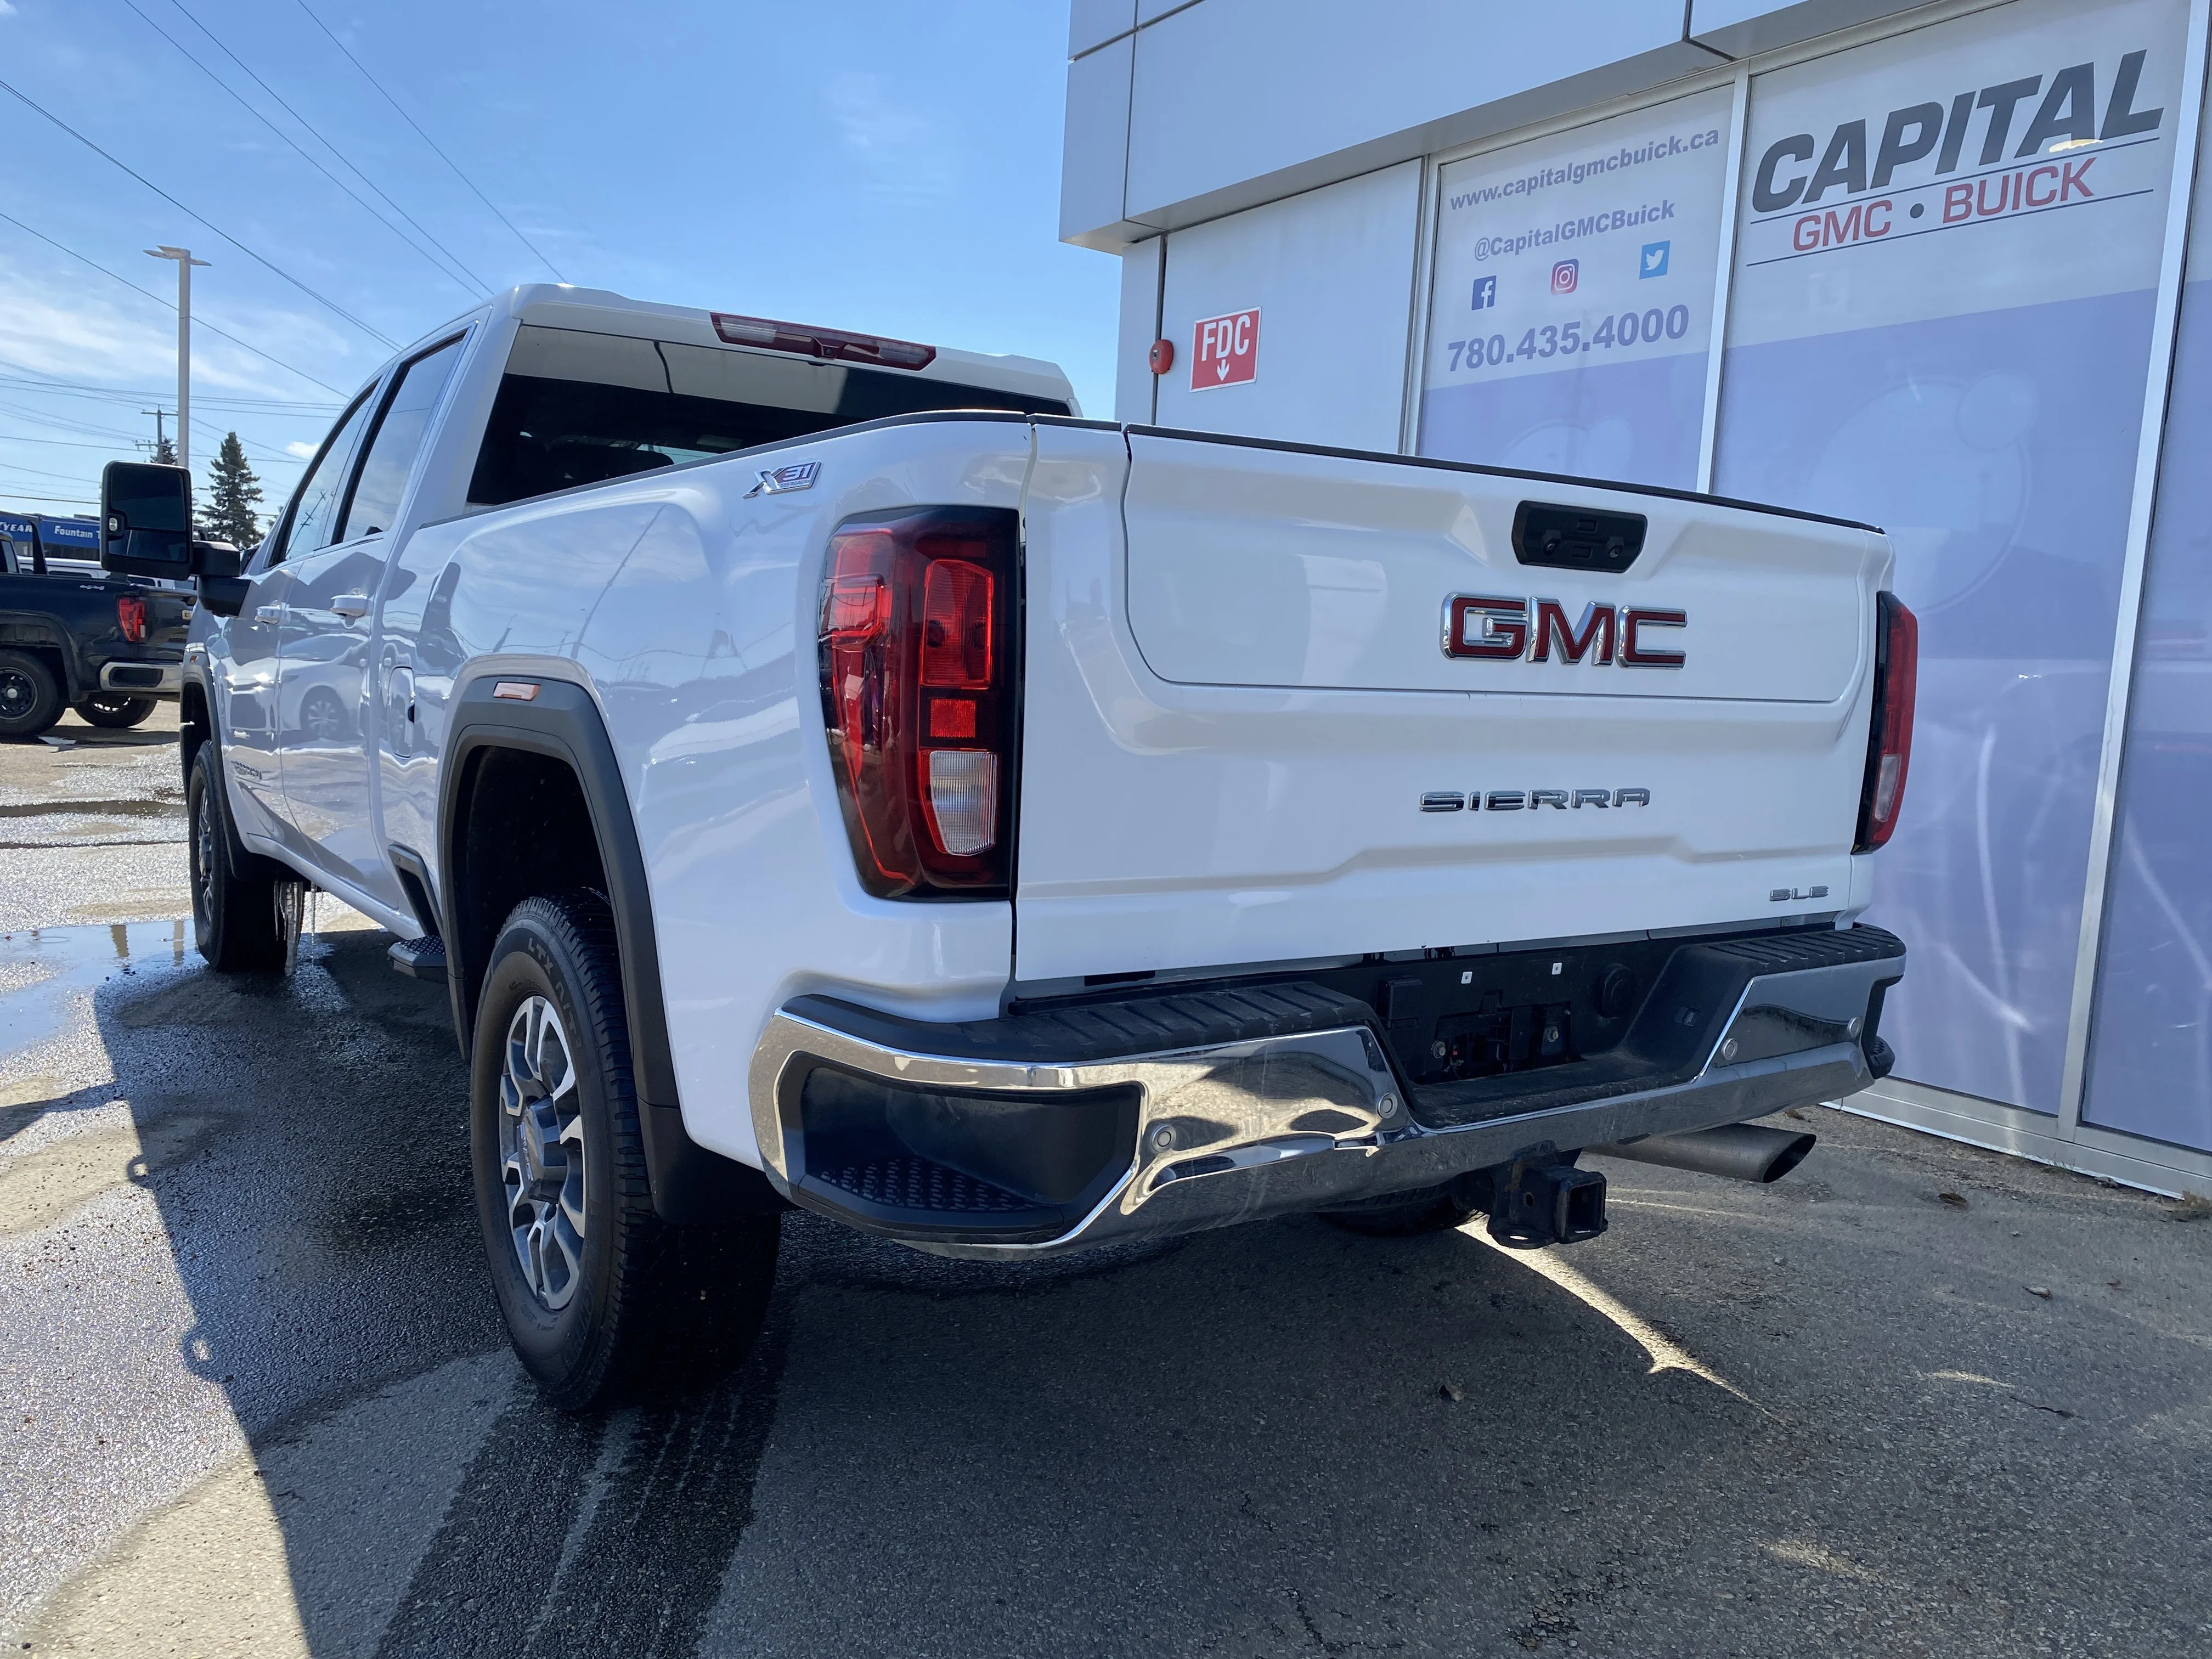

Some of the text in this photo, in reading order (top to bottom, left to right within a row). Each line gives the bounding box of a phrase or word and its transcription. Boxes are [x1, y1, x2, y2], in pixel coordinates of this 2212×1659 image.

[1752, 49, 2164, 213] CAPITAL
[1450, 129, 1719, 210] www.capitalgmcbuick.ca
[1474, 200, 1675, 261] @CapitalGMCBuick
[1792, 157, 2097, 251] GMC BUICK
[1201, 314, 1251, 362] FDC
[1447, 304, 1689, 372] 780.435.4000
[54, 525, 93, 539] Fountain
[1440, 591, 1688, 669] GMC
[1420, 787, 1651, 812] SIERRA
[1769, 885, 1829, 901] SLE
[528, 937, 554, 976] LTX
